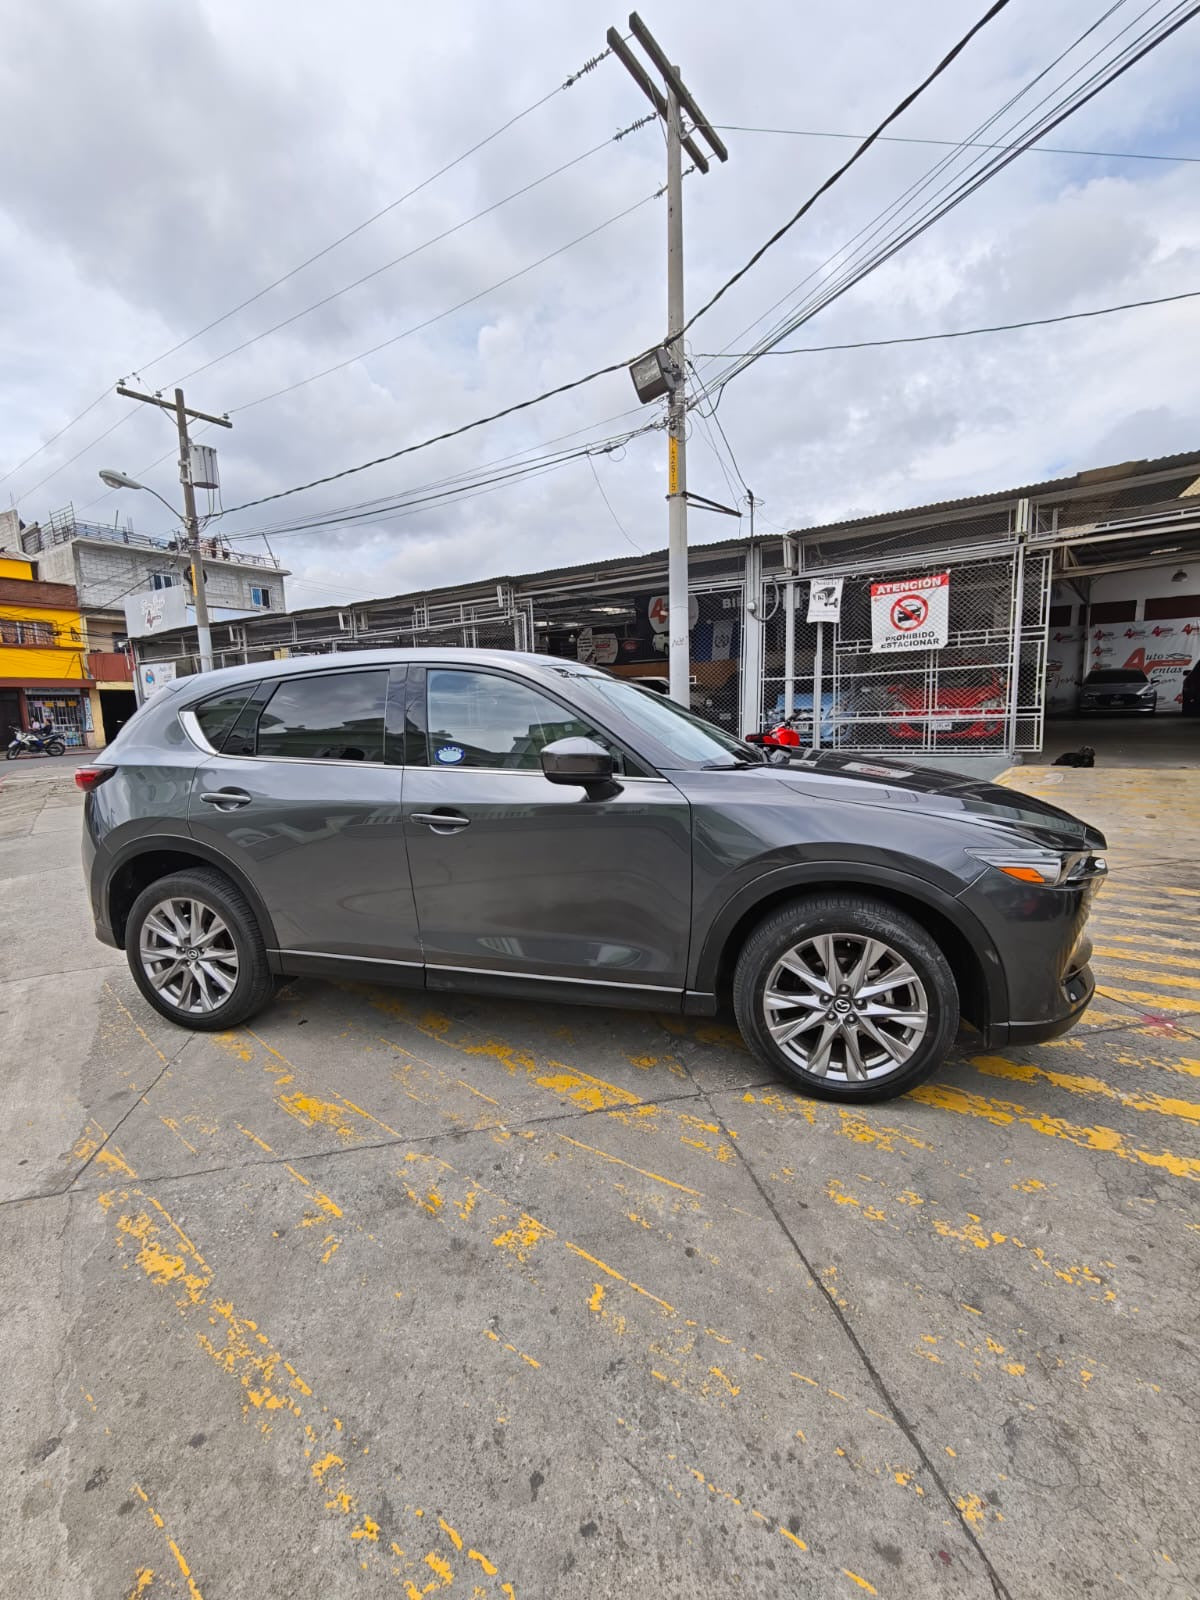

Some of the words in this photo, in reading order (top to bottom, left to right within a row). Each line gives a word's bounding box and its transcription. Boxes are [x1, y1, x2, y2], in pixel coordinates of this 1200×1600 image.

[876, 576, 942, 595] ATENCIÓN
[885, 631, 936, 643] PROHIBIDO
[881, 638, 941, 649] ESTACIONAR
